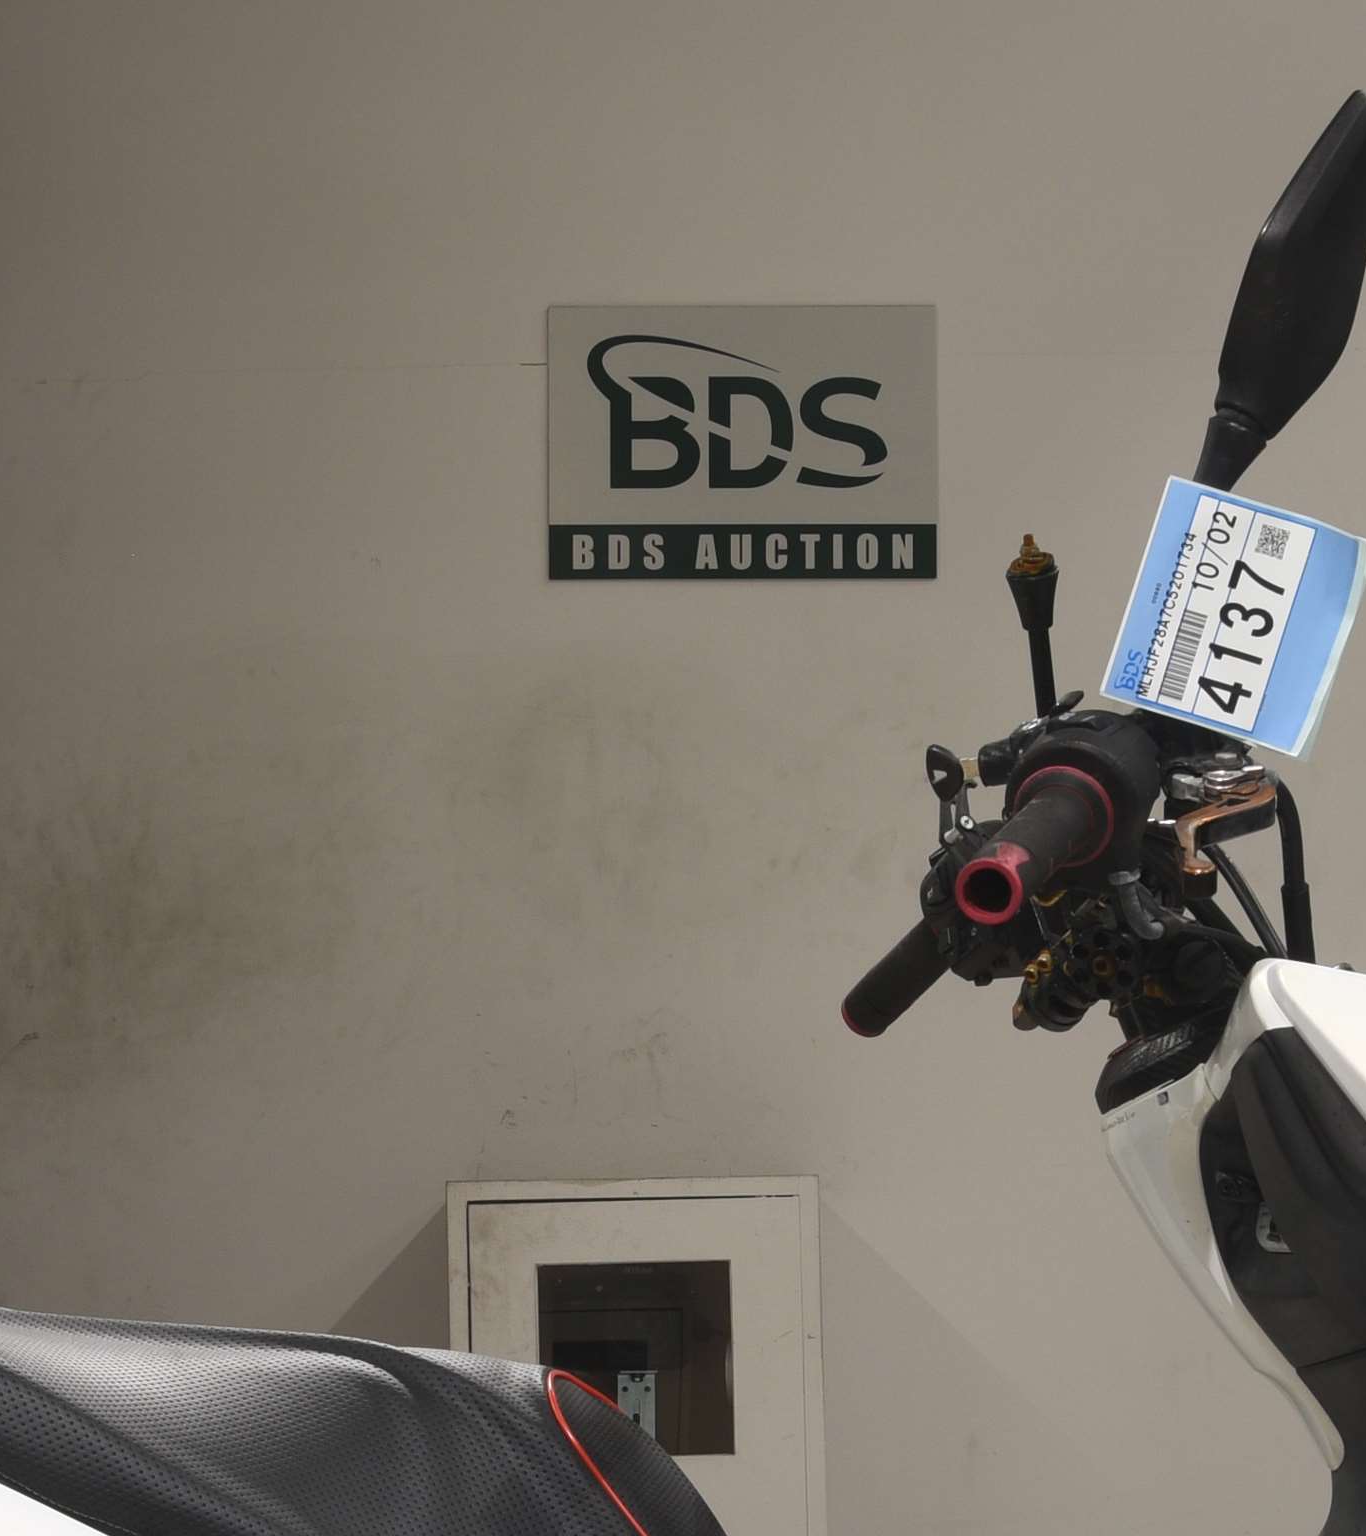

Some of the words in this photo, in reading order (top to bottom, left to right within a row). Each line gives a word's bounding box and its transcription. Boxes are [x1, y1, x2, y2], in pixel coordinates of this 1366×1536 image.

[588, 335, 889, 489] BDS
[572, 533, 665, 570] BDS
[695, 533, 914, 570] AUCTION
[1191, 511, 1237, 592] 10/02
[1114, 648, 1143, 691] BDS
[1198, 559, 1285, 714] 4137
